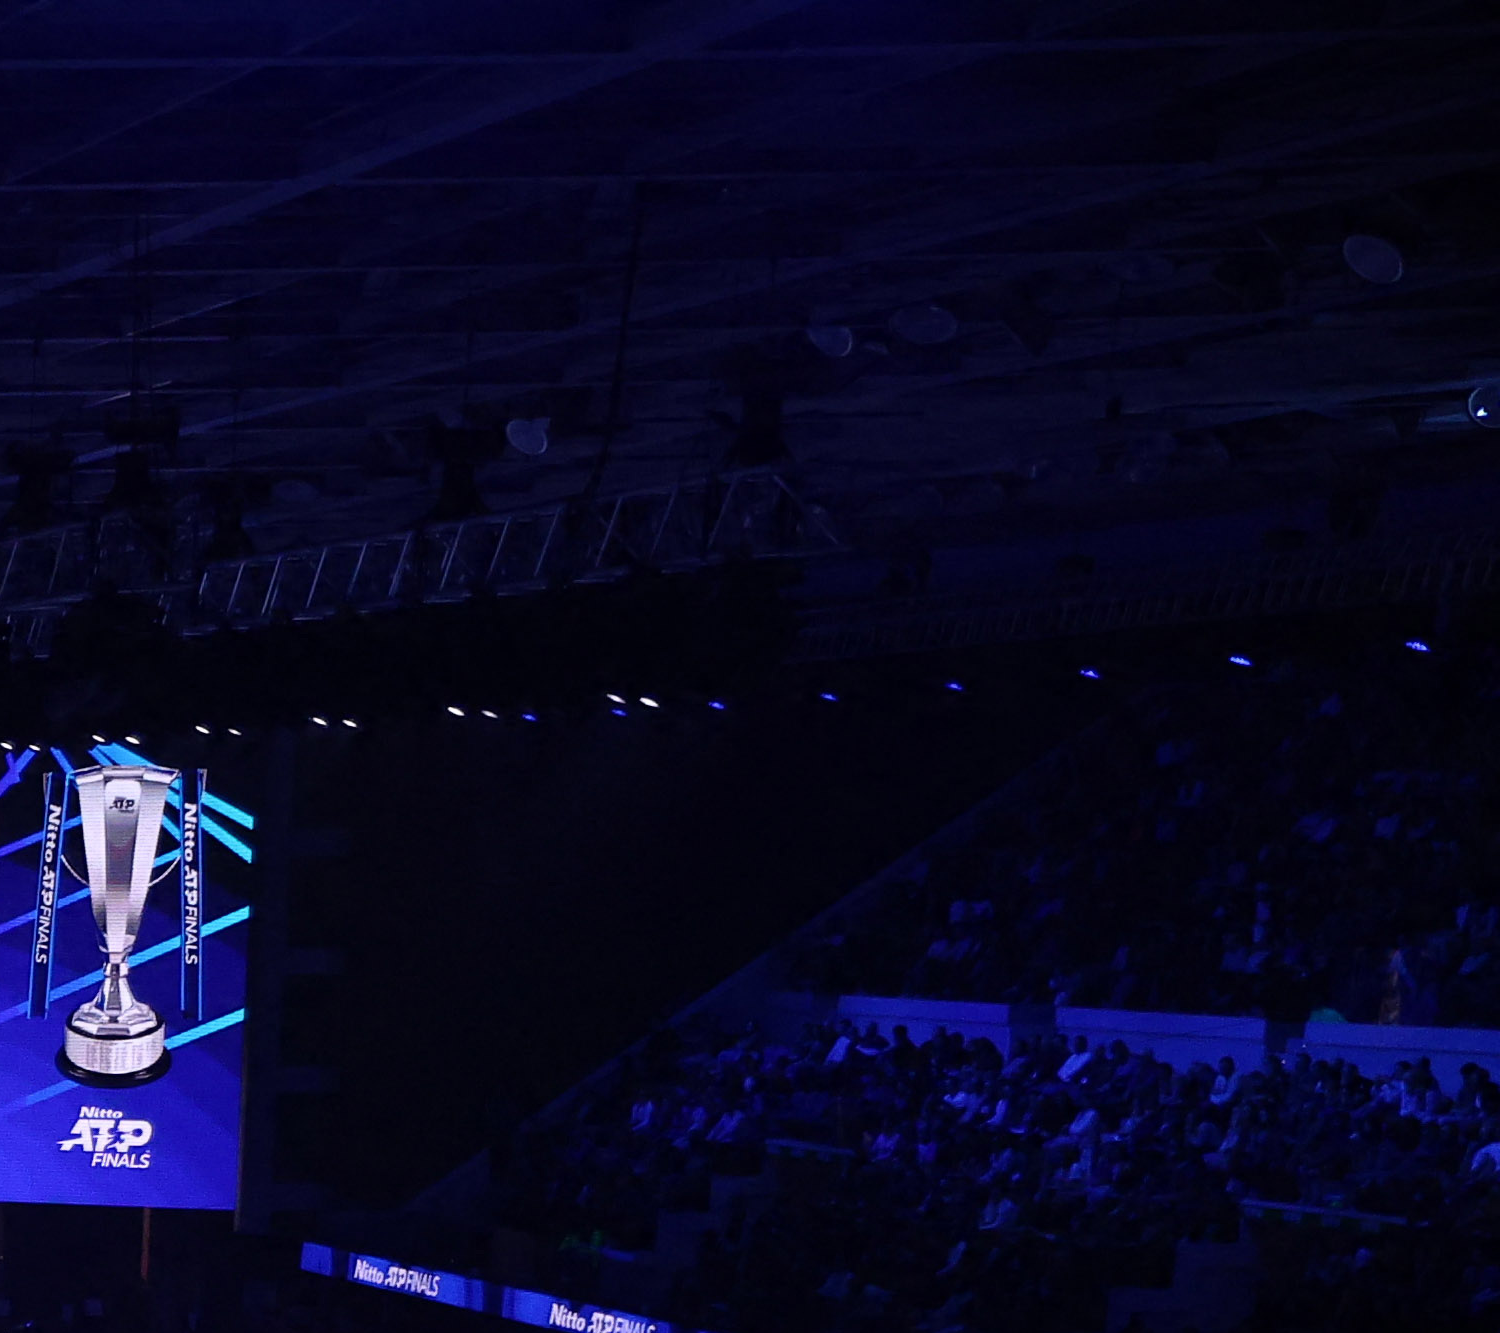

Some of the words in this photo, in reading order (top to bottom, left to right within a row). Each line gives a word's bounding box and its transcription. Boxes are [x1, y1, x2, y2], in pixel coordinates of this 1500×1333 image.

[46, 803, 62, 864] Nitto
[183, 802, 198, 864] Nitto
[41, 866, 59, 906] ATP
[183, 866, 199, 906] ATP
[35, 904, 53, 965] FINALS
[185, 904, 199, 966] FINALS
[79, 1105, 124, 1119] Nitto
[56, 1118, 152, 1153] ATP
[91, 1151, 151, 1170] FINALS
[353, 1258, 384, 1287] Nitto
[404, 1269, 440, 1298] FINALS
[548, 1302, 586, 1332] Nitto
